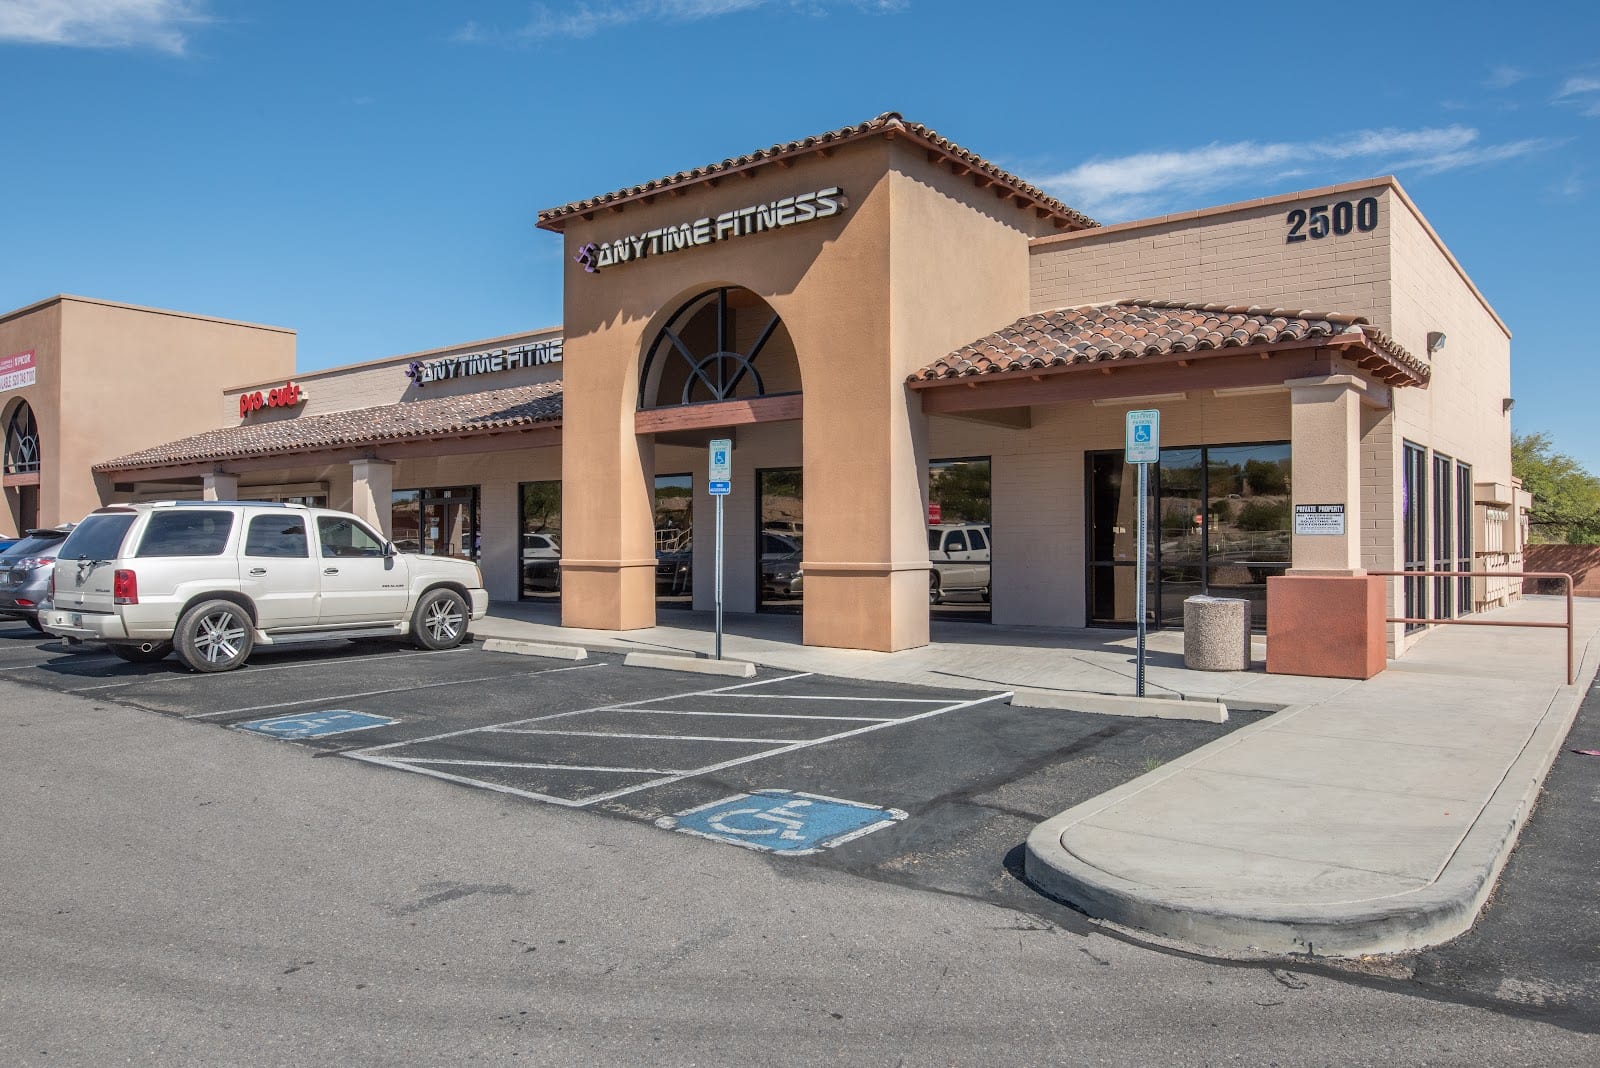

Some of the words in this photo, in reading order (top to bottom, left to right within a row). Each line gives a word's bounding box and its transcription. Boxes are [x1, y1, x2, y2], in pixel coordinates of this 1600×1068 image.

[598, 217, 711, 268] ANYTIME
[716, 186, 841, 241] FITNESS
[1286, 197, 1378, 244] 2500
[421, 350, 503, 382] ANYTIME
[240, 391, 263, 418] pro
[268, 380, 300, 408] cuts
[1296, 505, 1317, 513] PRIVATE
[1318, 505, 1344, 513] PROPERTY
